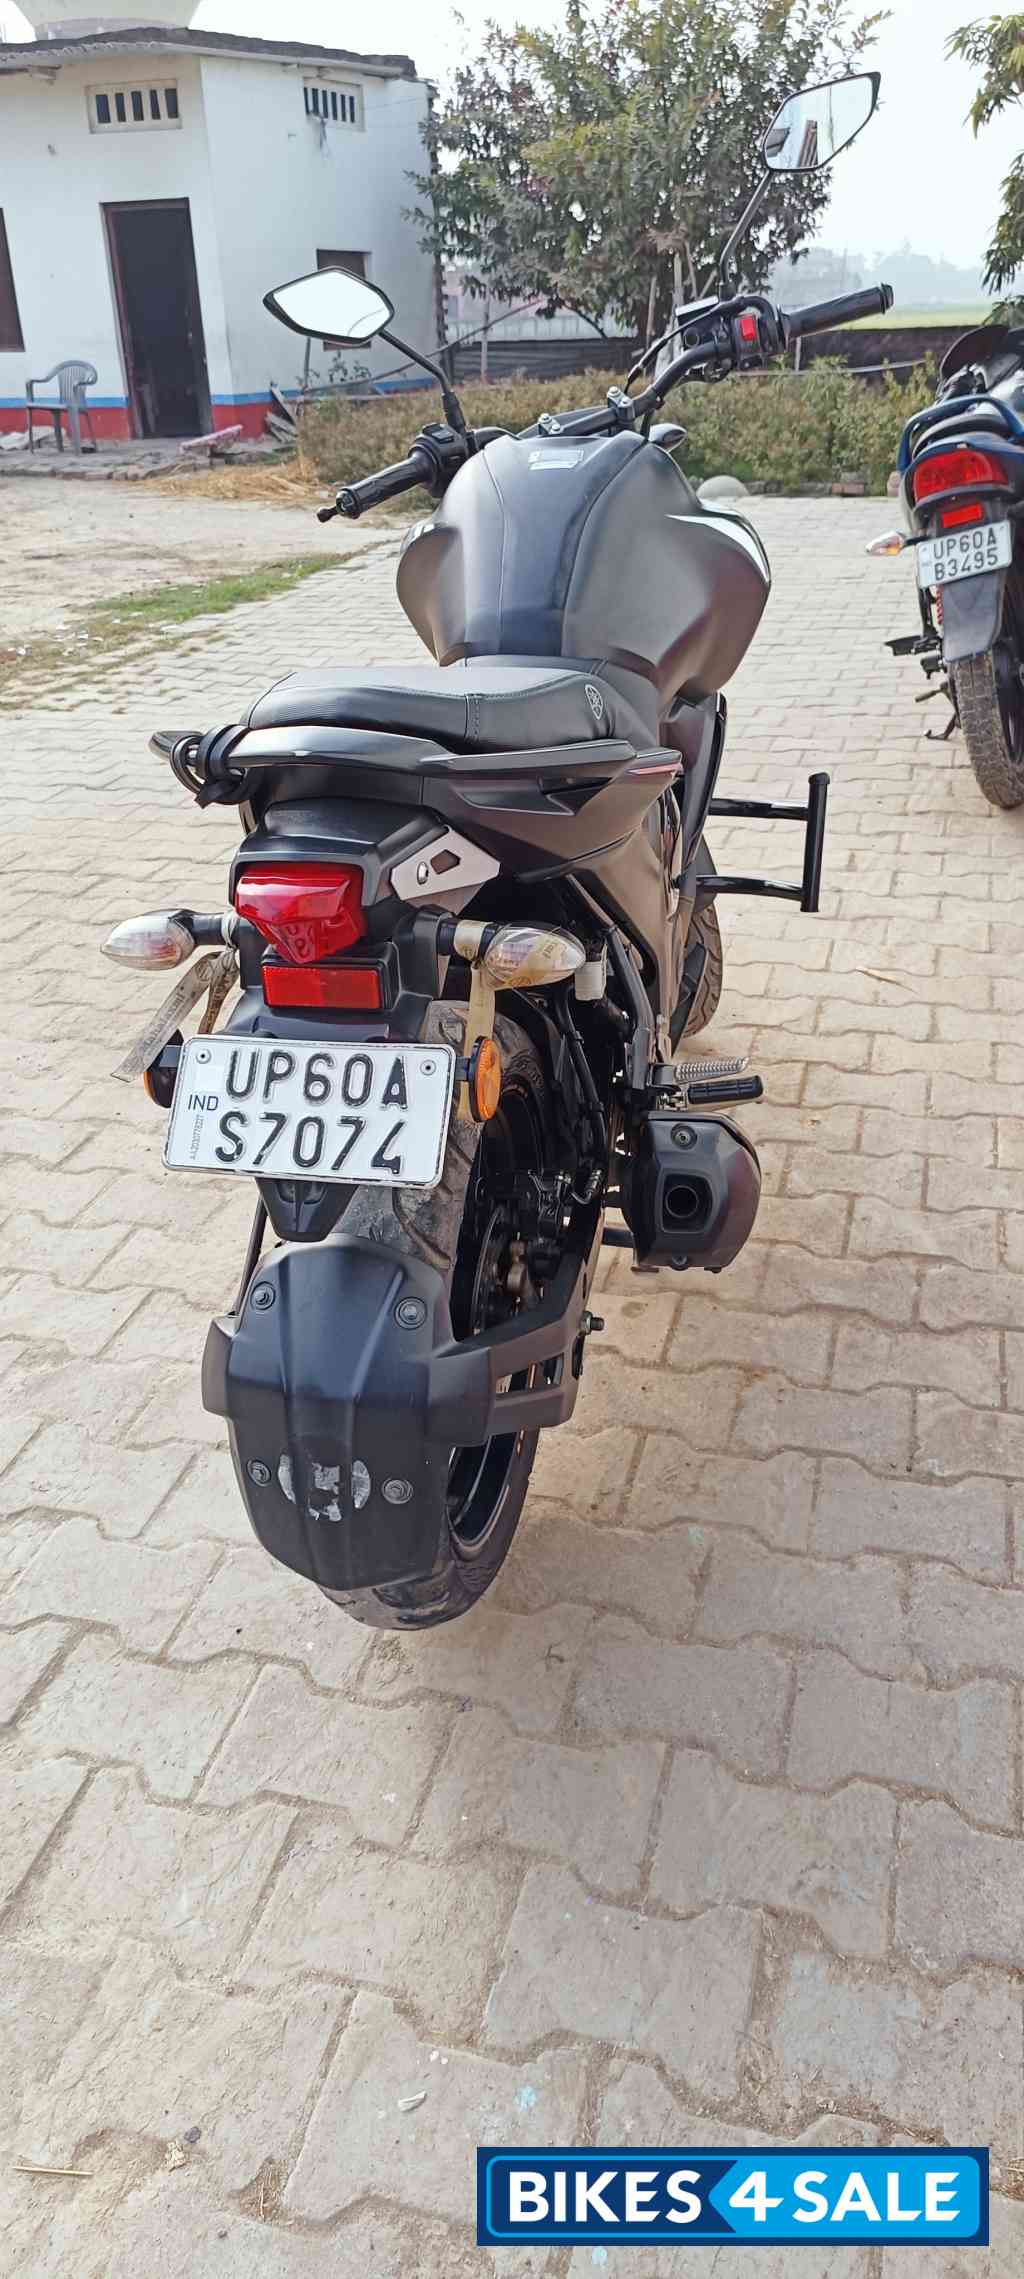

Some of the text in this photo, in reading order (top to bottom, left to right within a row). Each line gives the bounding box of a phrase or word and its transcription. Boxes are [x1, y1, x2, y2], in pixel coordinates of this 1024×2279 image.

[933, 527, 997, 560] UP60A
[934, 547, 998, 581] B3495
[225, 1049, 408, 1110] UP60A
[187, 1094, 219, 1111] IND
[214, 1110, 405, 1175] S7074
